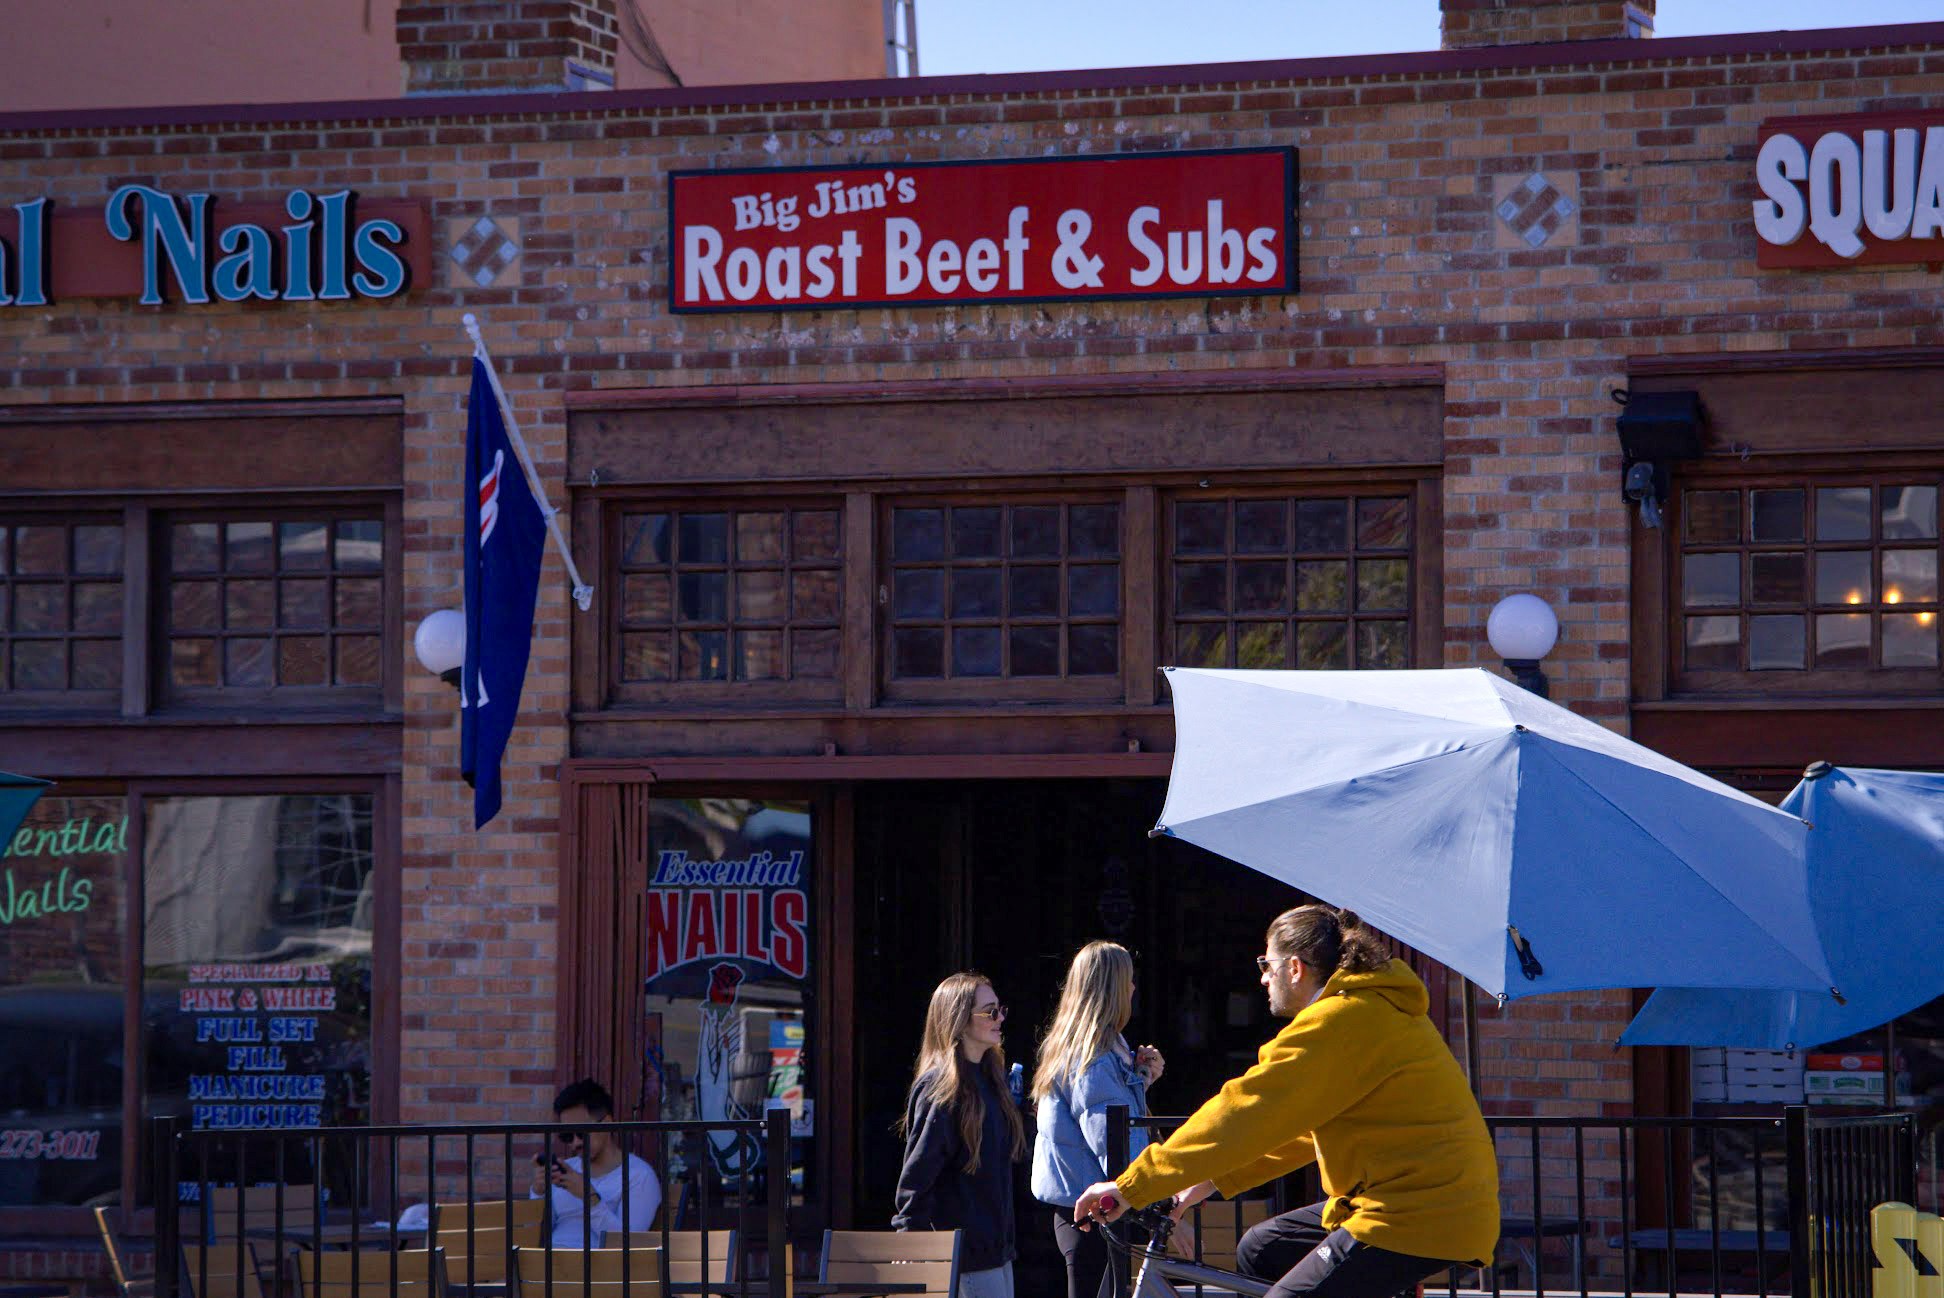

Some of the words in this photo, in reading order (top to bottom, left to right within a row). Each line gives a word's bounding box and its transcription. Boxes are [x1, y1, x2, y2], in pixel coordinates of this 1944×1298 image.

[731, 192, 800, 232] Big
[807, 170, 916, 218] Jim's
[0, 197, 46, 306] l
[105, 184, 405, 304] Nails
[684, 225, 862, 302] Roast
[885, 206, 1029, 296] Beef
[1051, 208, 1105, 289] &
[1127, 200, 1278, 288] Subs
[4, 816, 128, 857] ential
[651, 850, 804, 886] Essential
[646, 888, 808, 984] NAILS
[189, 963, 302, 983] SPECIALIZED
[179, 987, 234, 1011] PINK
[238, 987, 258, 1011] &
[260, 986, 337, 1011] WHITE
[196, 1017, 262, 1042] FULL
[268, 1017, 319, 1041] SET
[227, 1046, 287, 1071] FILL
[188, 1074, 326, 1100] MANICURE
[192, 1104, 322, 1129] PEDICURE
[0, 1130, 100, 1160] 273-3011
